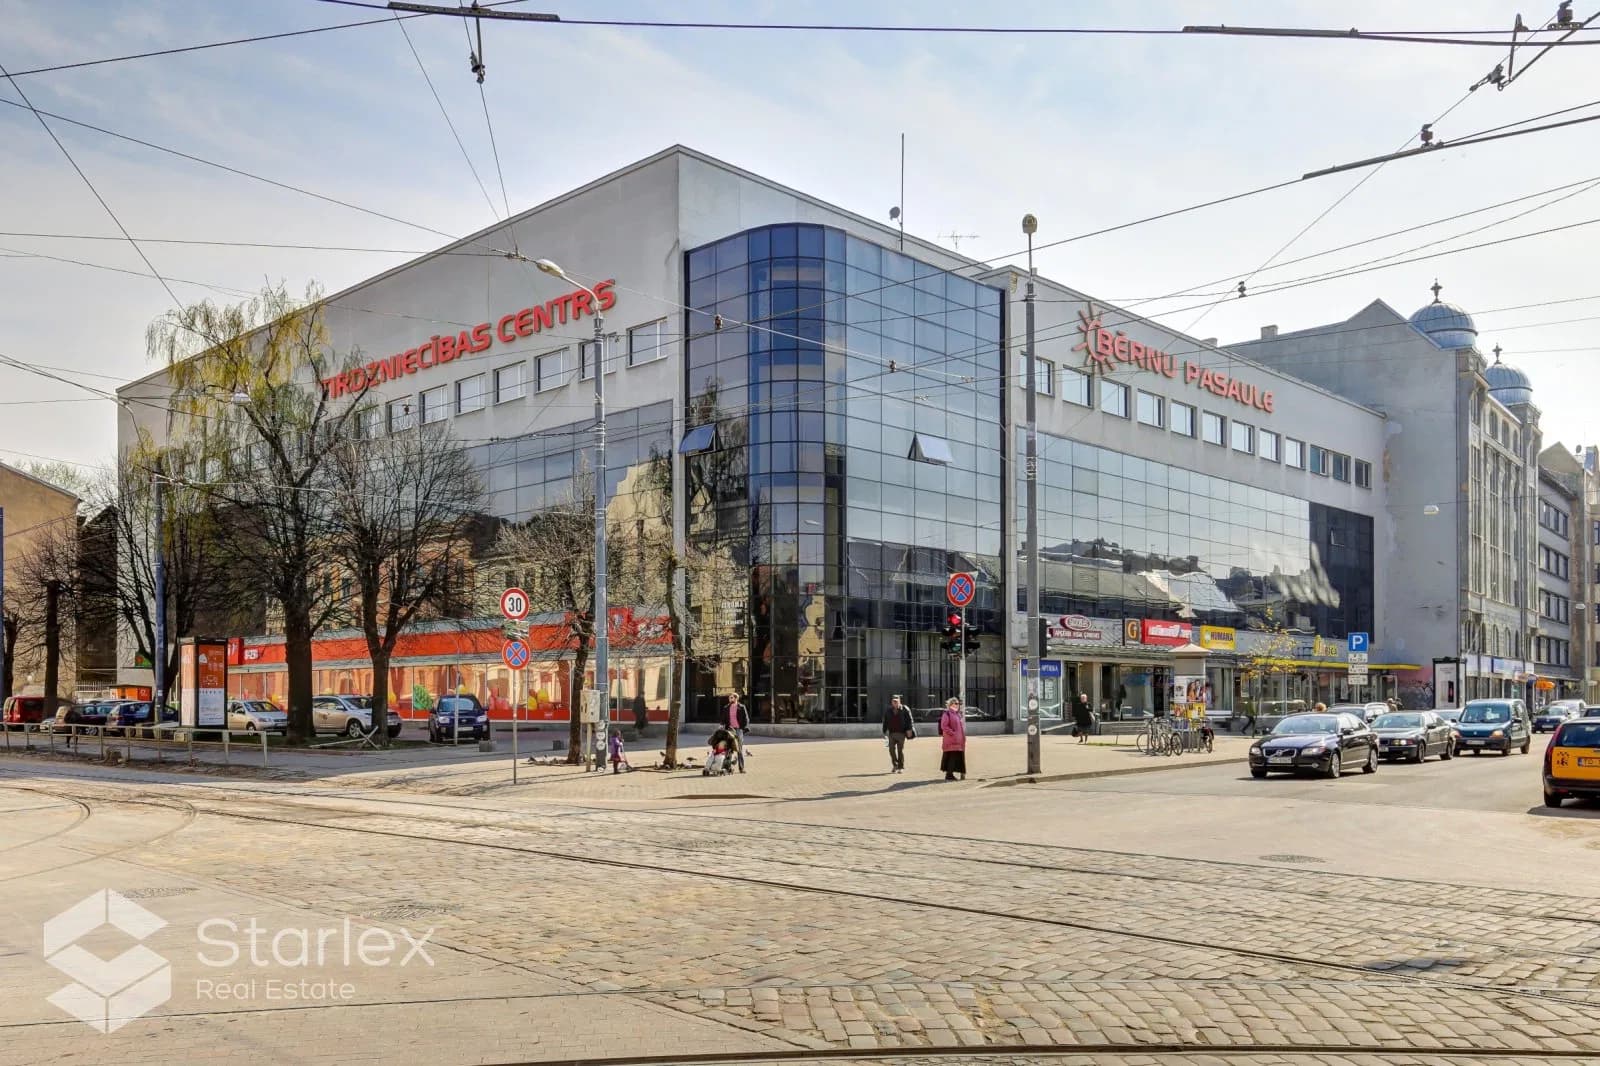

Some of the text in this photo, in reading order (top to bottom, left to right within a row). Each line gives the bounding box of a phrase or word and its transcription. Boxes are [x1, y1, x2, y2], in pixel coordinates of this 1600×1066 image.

[322, 279, 615, 398] TIRDZNIECĪBAS CENTRS
[1096, 328, 1274, 413] BĒRNU PASAULE
[508, 597, 522, 612] 30
[1210, 631, 1233, 641] HUMANA
[1352, 635, 1364, 650] P
